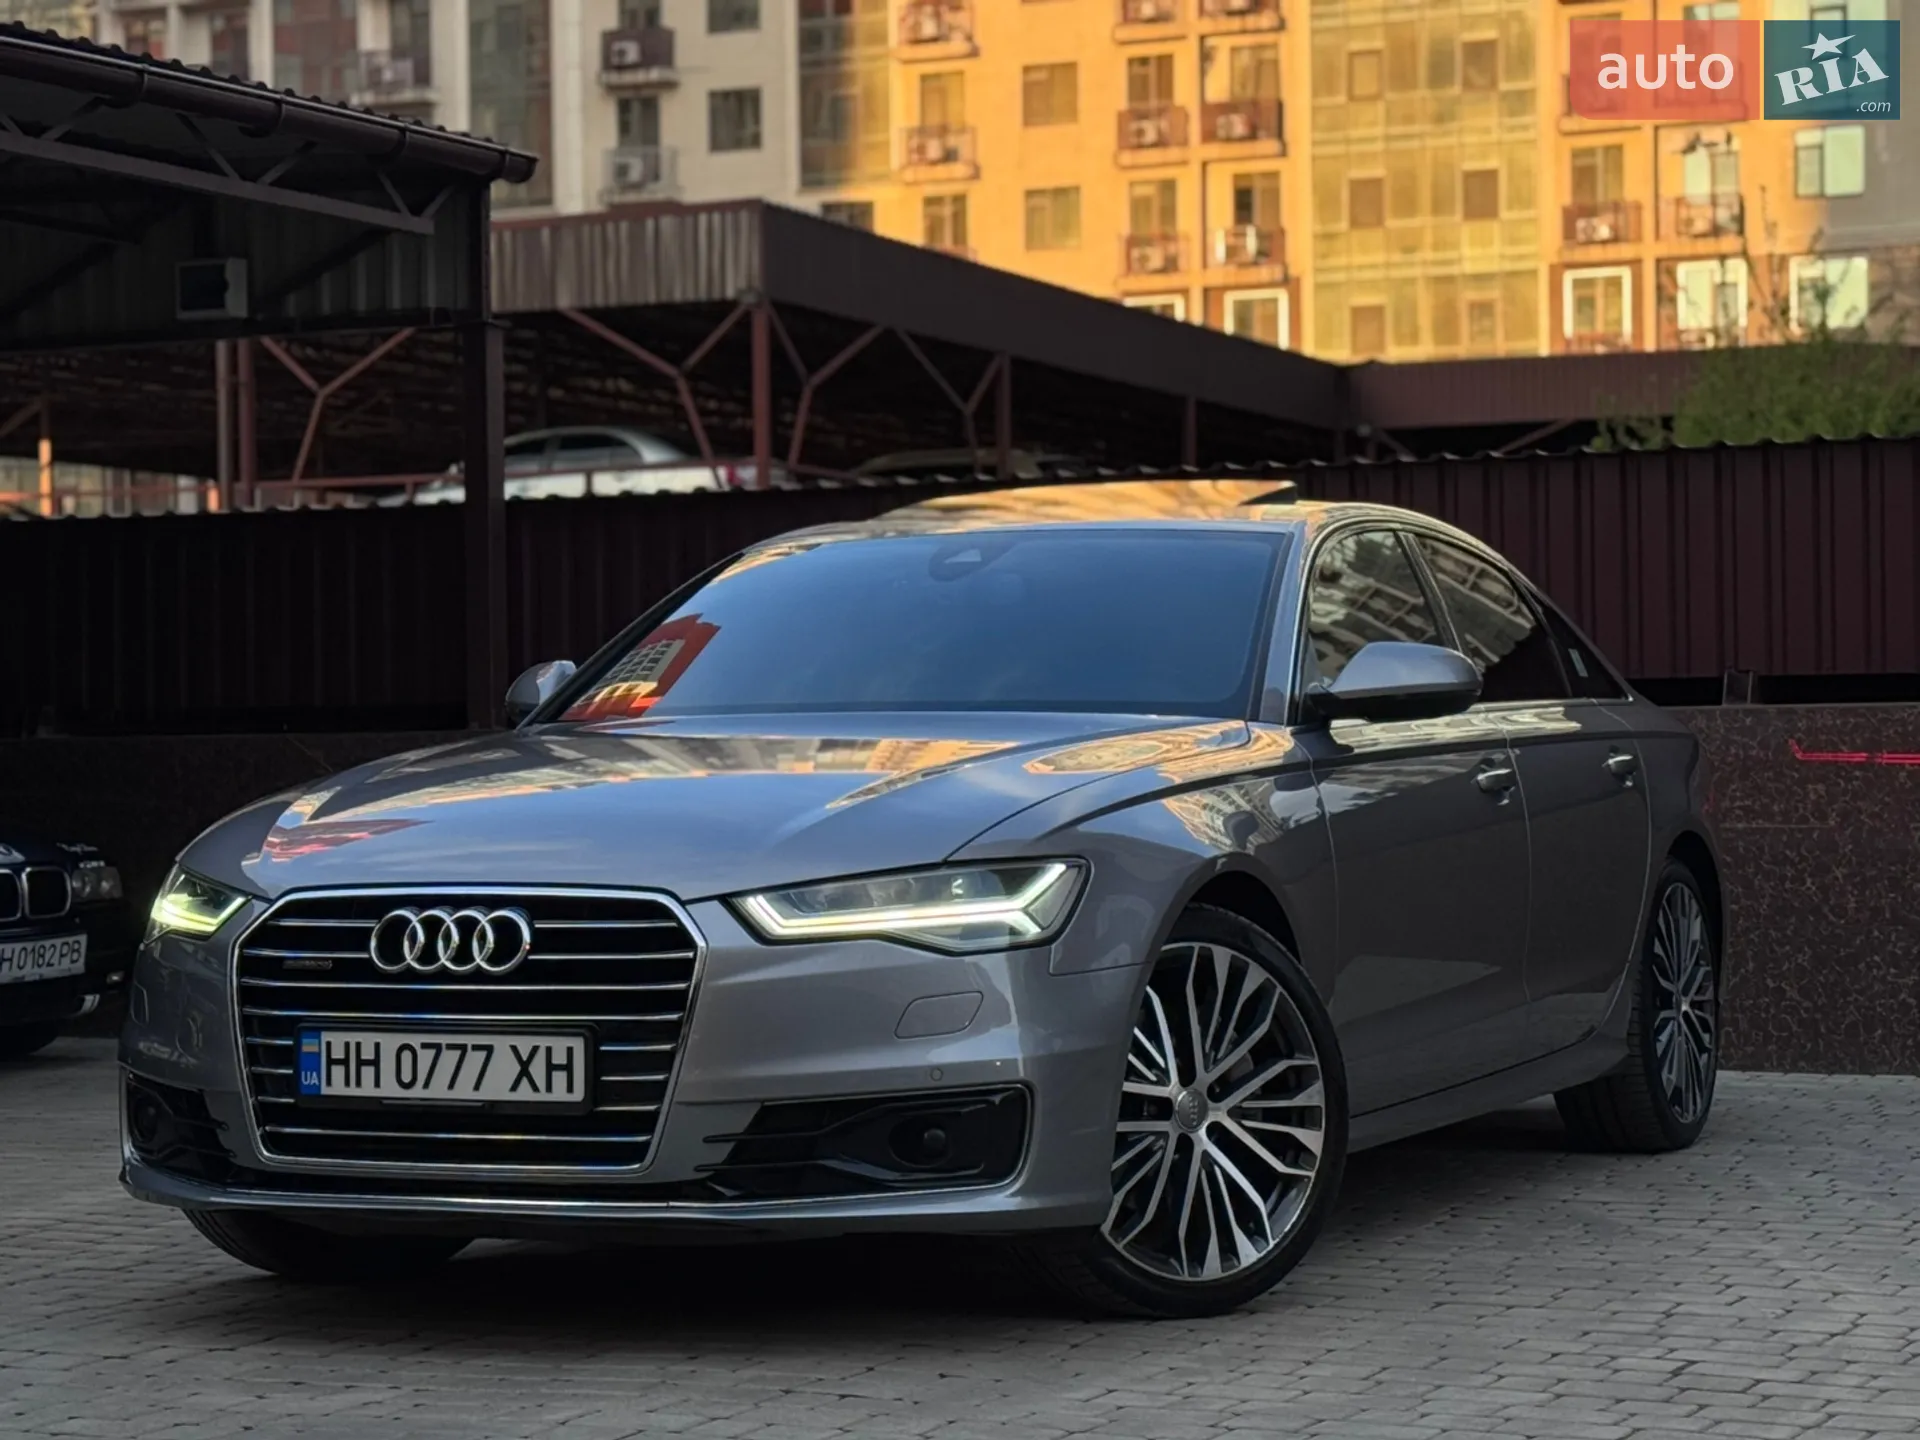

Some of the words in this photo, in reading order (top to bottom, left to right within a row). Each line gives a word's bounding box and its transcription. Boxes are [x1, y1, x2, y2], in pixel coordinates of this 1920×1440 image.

[17, 943, 57, 970] 0182
[59, 940, 82, 966] PB
[301, 1071, 319, 1086] UA
[325, 1040, 381, 1088] HH
[395, 1042, 494, 1091] 0777
[508, 1044, 575, 1094] XH
